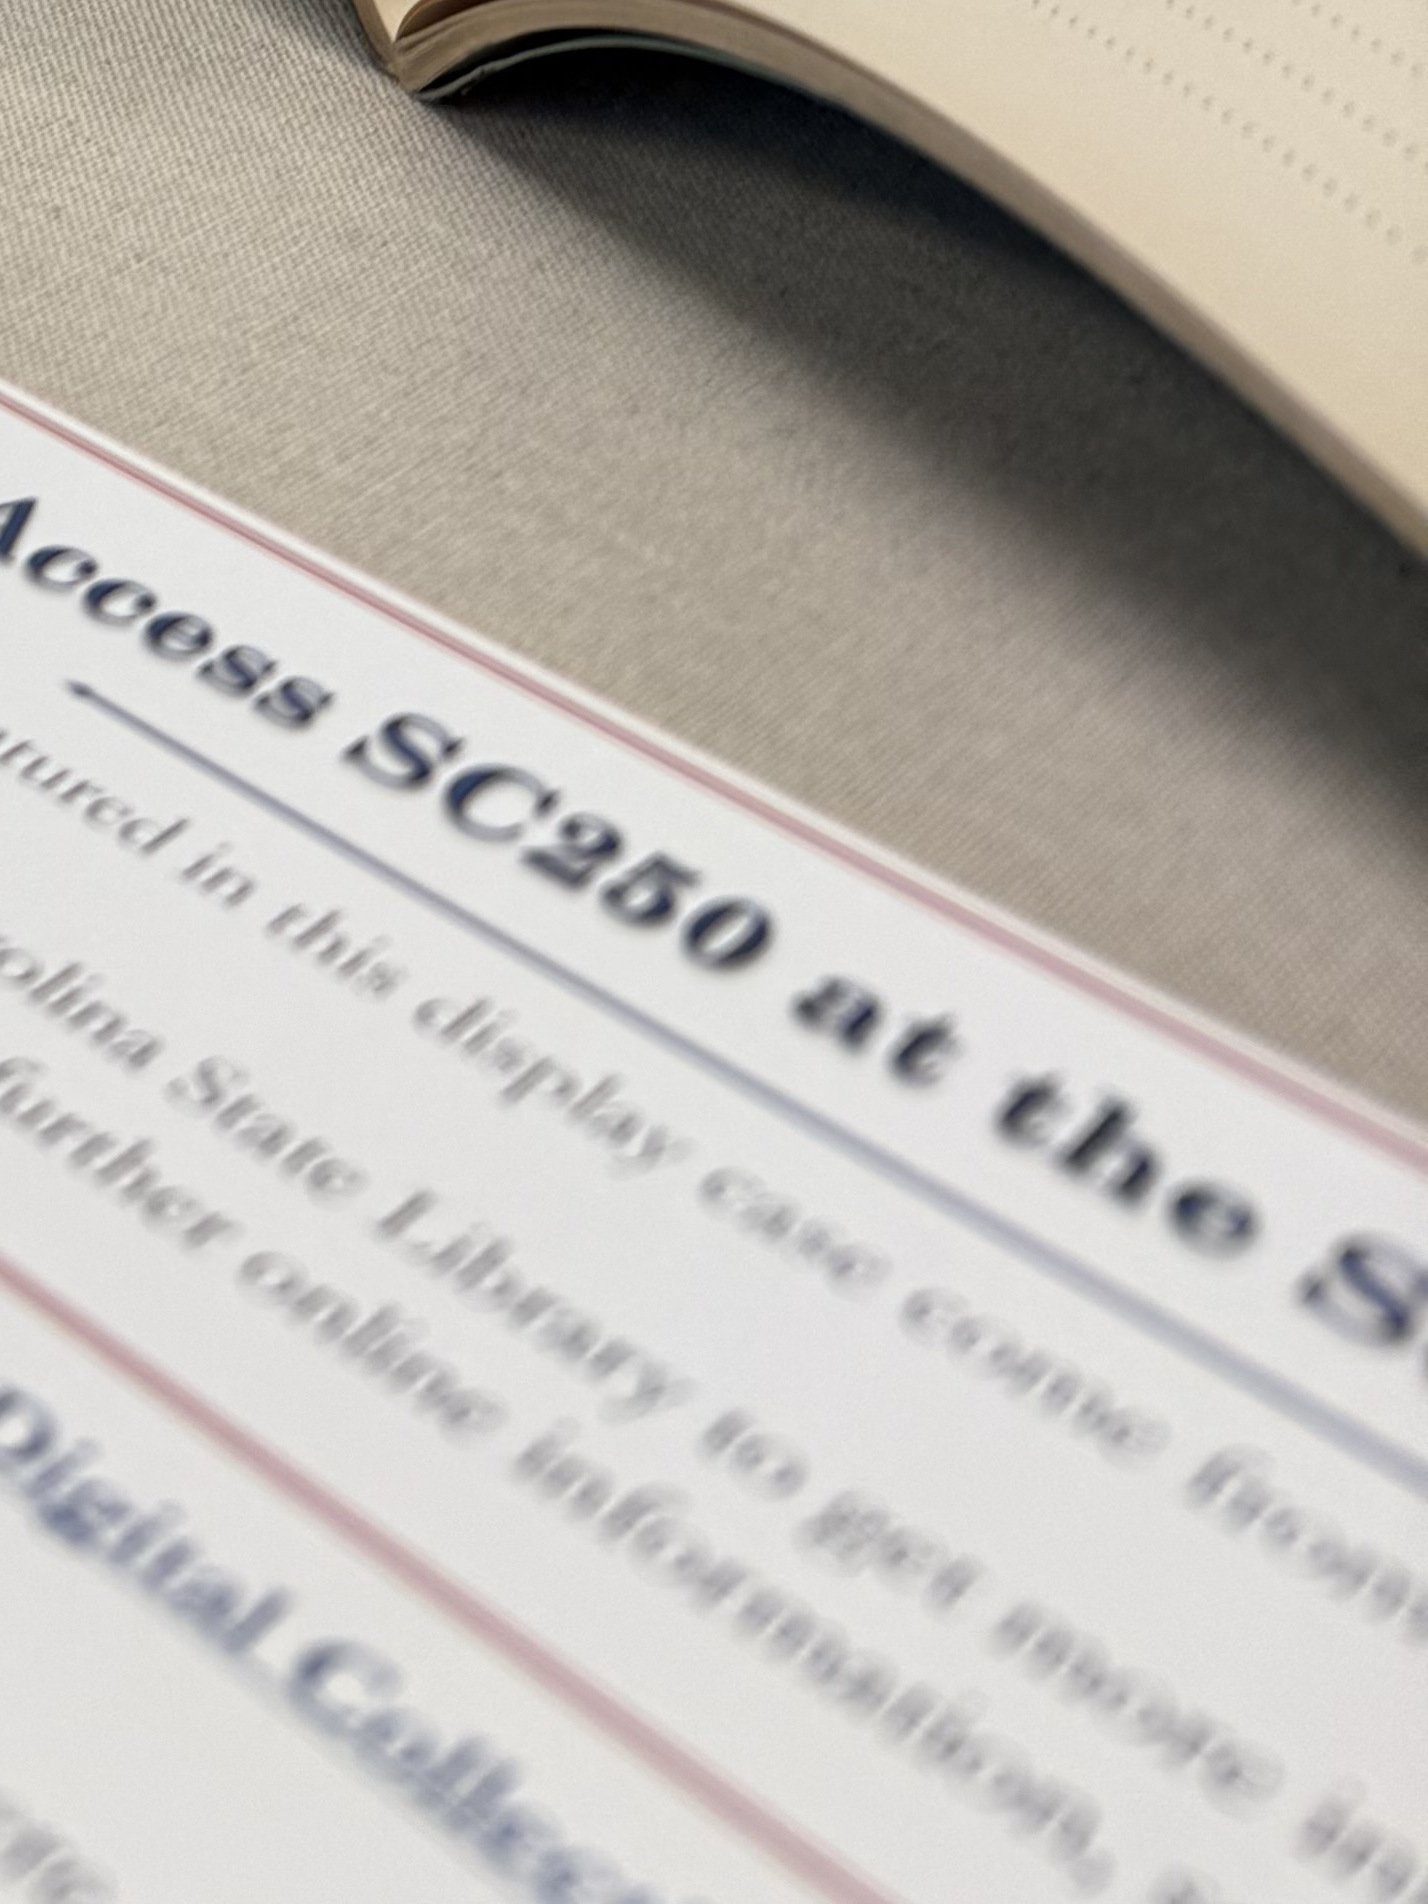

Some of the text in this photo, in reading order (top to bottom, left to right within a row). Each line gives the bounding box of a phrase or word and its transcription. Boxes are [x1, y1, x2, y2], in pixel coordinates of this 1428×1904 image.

[177, 841, 258, 911] in
[263, 901, 402, 999] this
[410, 995, 680, 1172] display
[341, 712, 776, 975] SC250
[791, 977, 956, 1086] at
[994, 1076, 1261, 1253] the
[166, 1055, 364, 1200] State
[372, 1187, 677, 1419] Library
